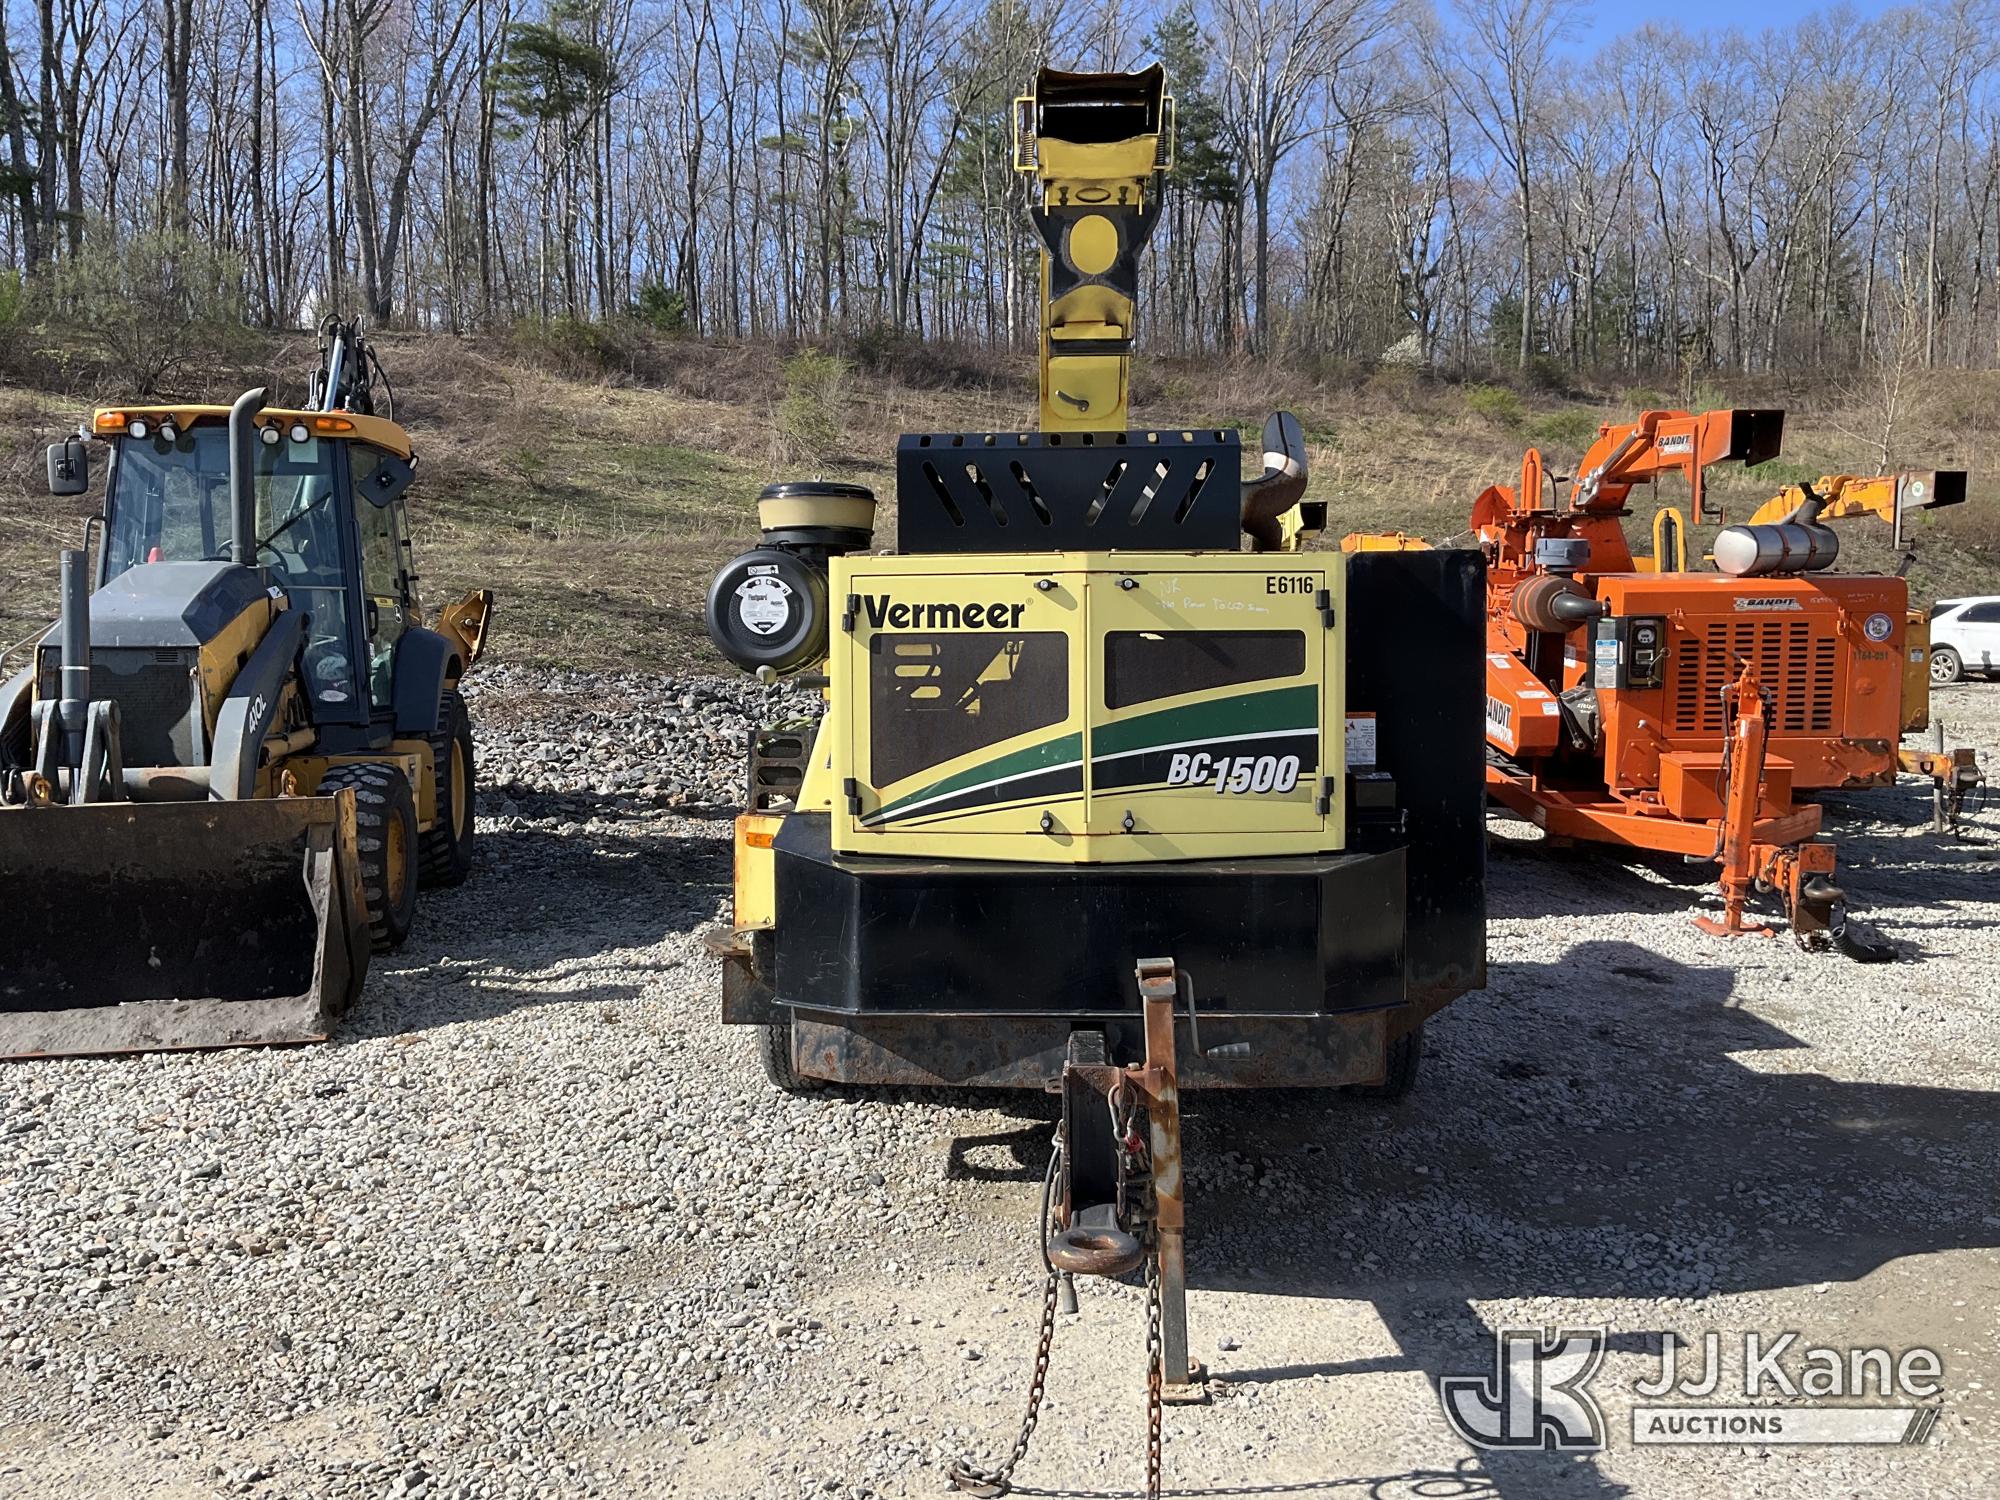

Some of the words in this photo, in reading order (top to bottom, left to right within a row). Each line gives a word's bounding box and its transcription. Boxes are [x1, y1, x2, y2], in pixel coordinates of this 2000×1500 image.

[1658, 435, 1691, 447] BANDIT
[1266, 576, 1314, 594] E6116
[863, 595, 1025, 629] Vermeer
[1747, 598, 1795, 606] BANDIT
[249, 693, 267, 734] 410L
[1167, 753, 1300, 794] BC1500
